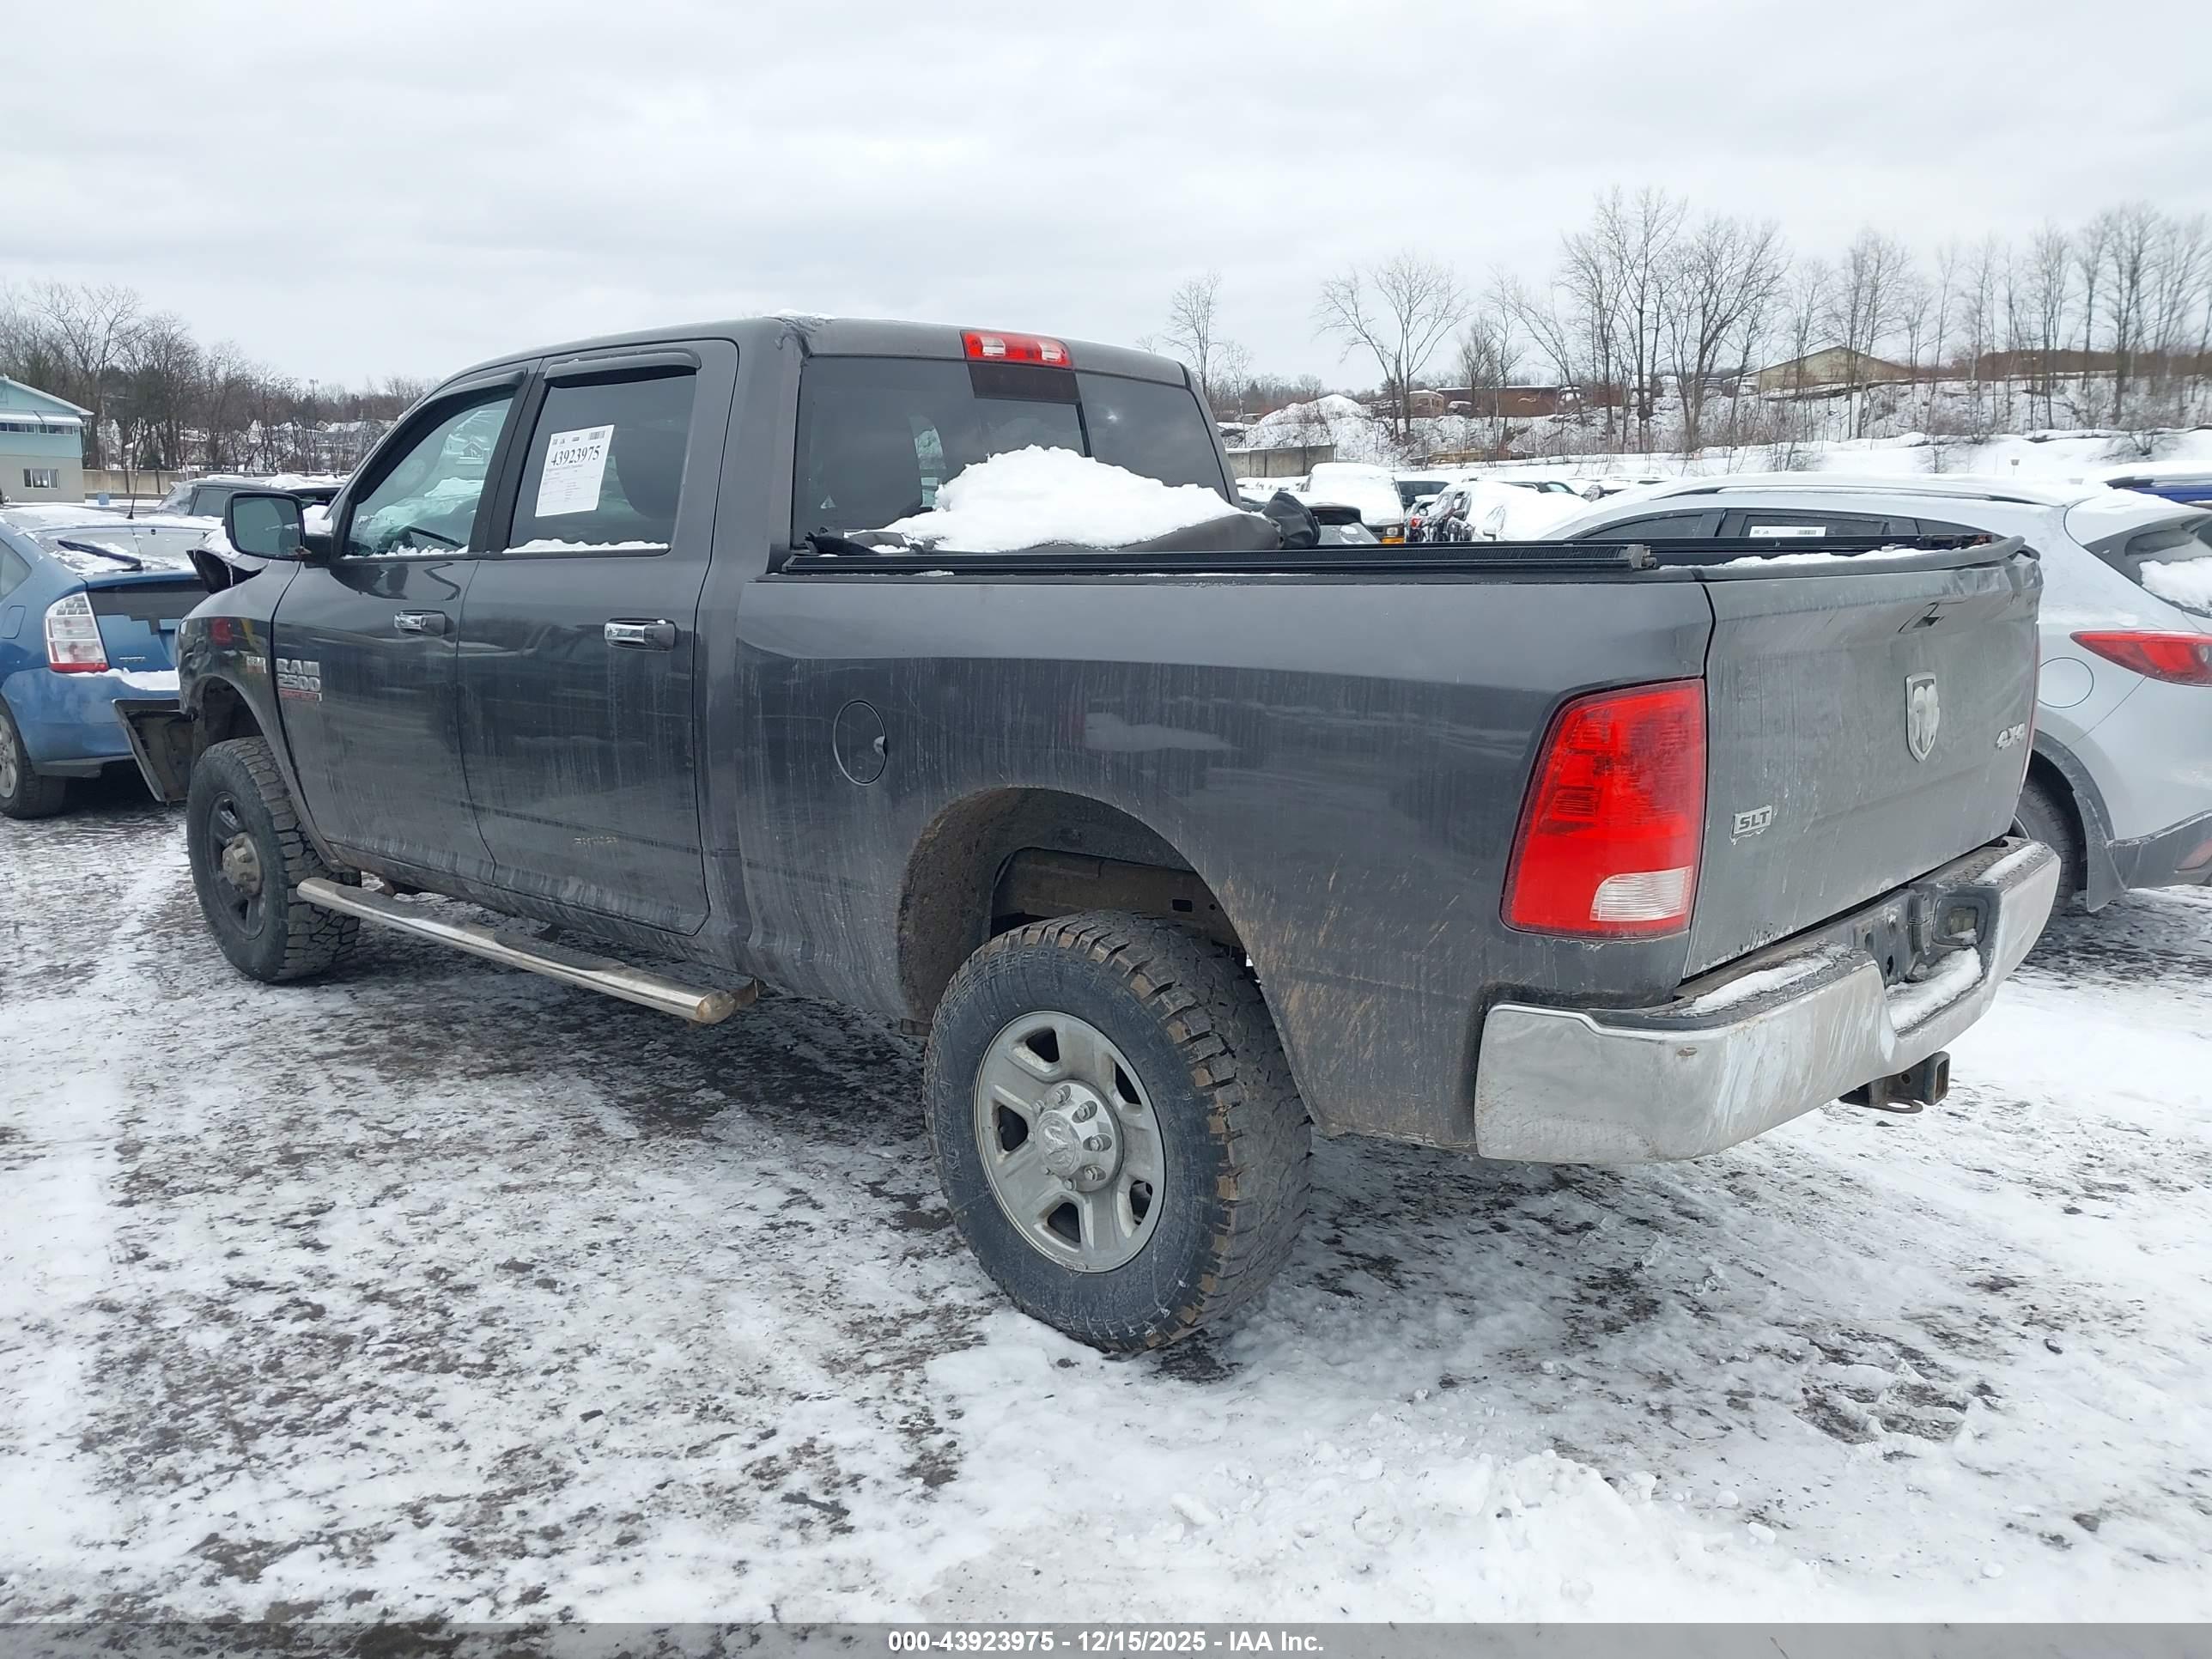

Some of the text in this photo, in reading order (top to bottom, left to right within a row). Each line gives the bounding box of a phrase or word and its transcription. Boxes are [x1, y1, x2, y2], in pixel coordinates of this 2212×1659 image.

[550, 445, 601, 466] 43923975
[276, 658, 319, 677] RAM
[276, 672, 320, 692] 2500
[1738, 810, 1771, 830] SLT
